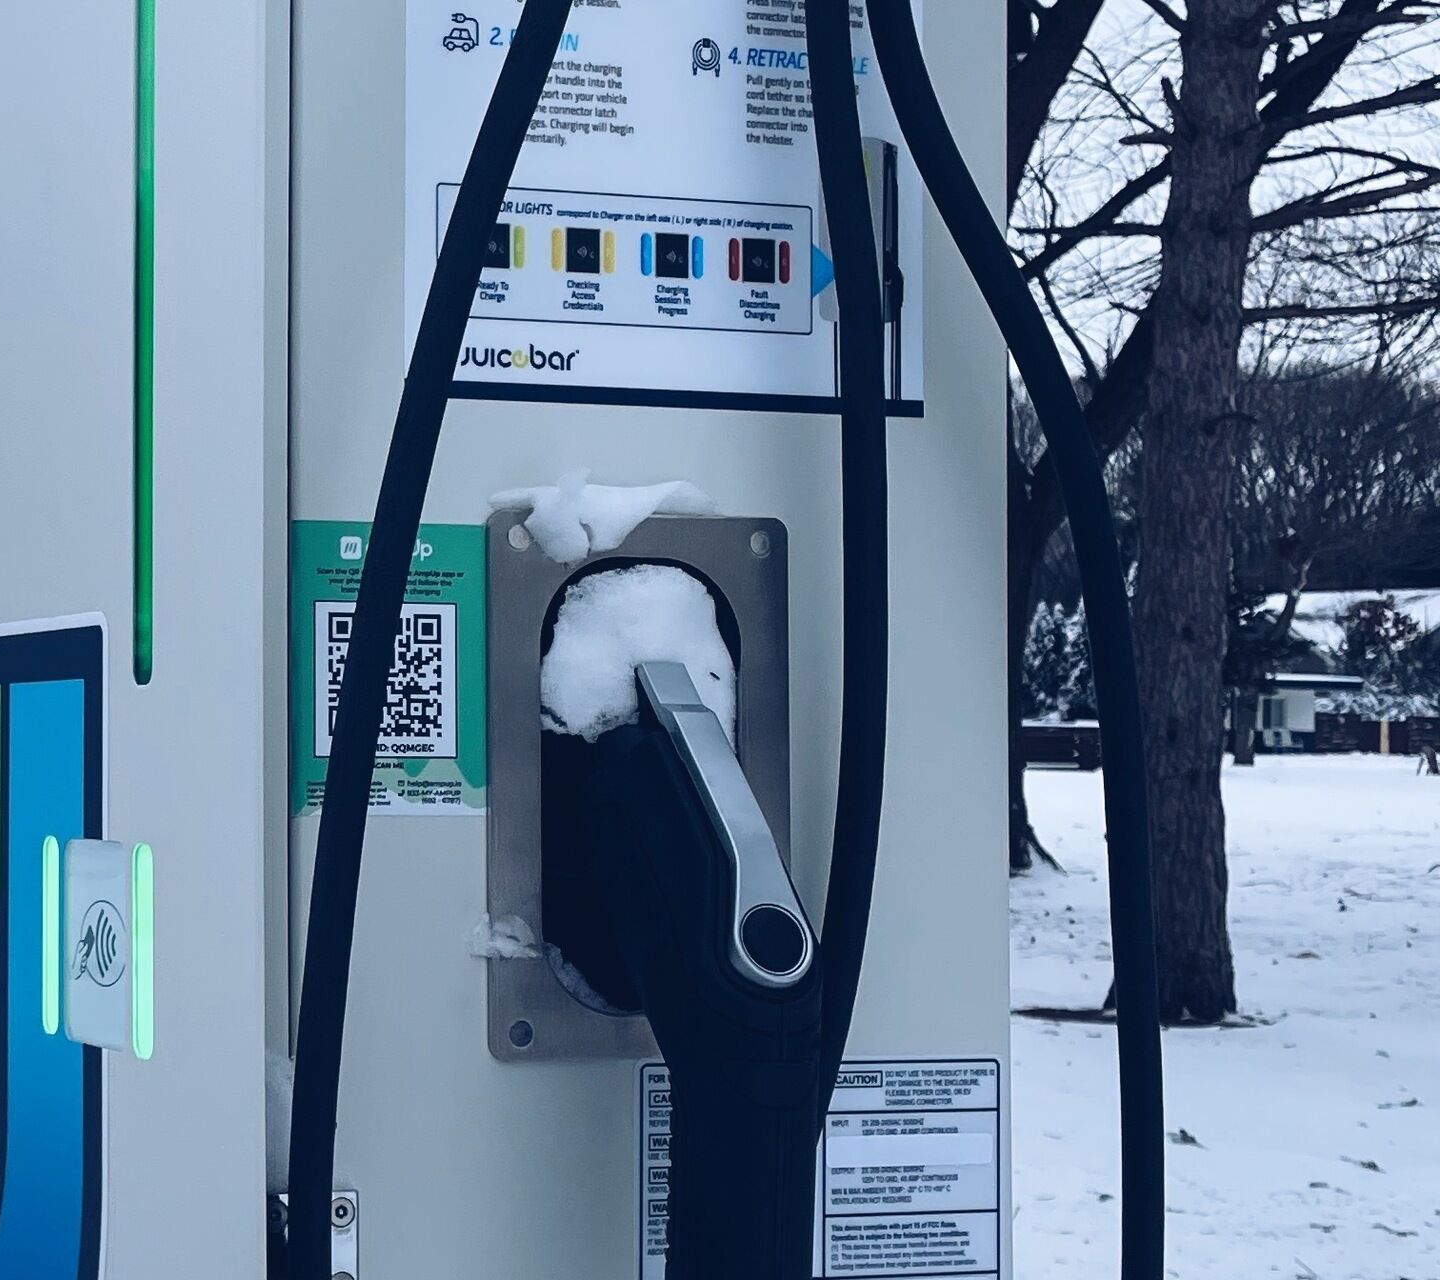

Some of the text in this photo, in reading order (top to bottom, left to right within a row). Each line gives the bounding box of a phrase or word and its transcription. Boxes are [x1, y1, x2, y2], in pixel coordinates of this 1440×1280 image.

[489, 26, 504, 46] 2.
[728, 46, 808, 70] 4. RETRAC
[566, 60, 582, 72] the
[583, 61, 623, 78] charging
[555, 75, 623, 90] handle into the
[574, 92, 594, 104] your
[596, 93, 628, 105] vehicle
[548, 105, 594, 117] connector
[594, 106, 618, 118] latch
[549, 118, 591, 134] Charging
[591, 121, 608, 132] will
[609, 122, 635, 137] begin
[515, 201, 554, 216] LIGHTS
[566, 279, 600, 293] Checking
[656, 284, 689, 297] Charging
[571, 290, 596, 301] Access
[750, 288, 769, 300] Fault
[743, 309, 777, 323] Charging
[648, 1074, 666, 1084] FOR
[835, 1074, 878, 1086] CAUTION
